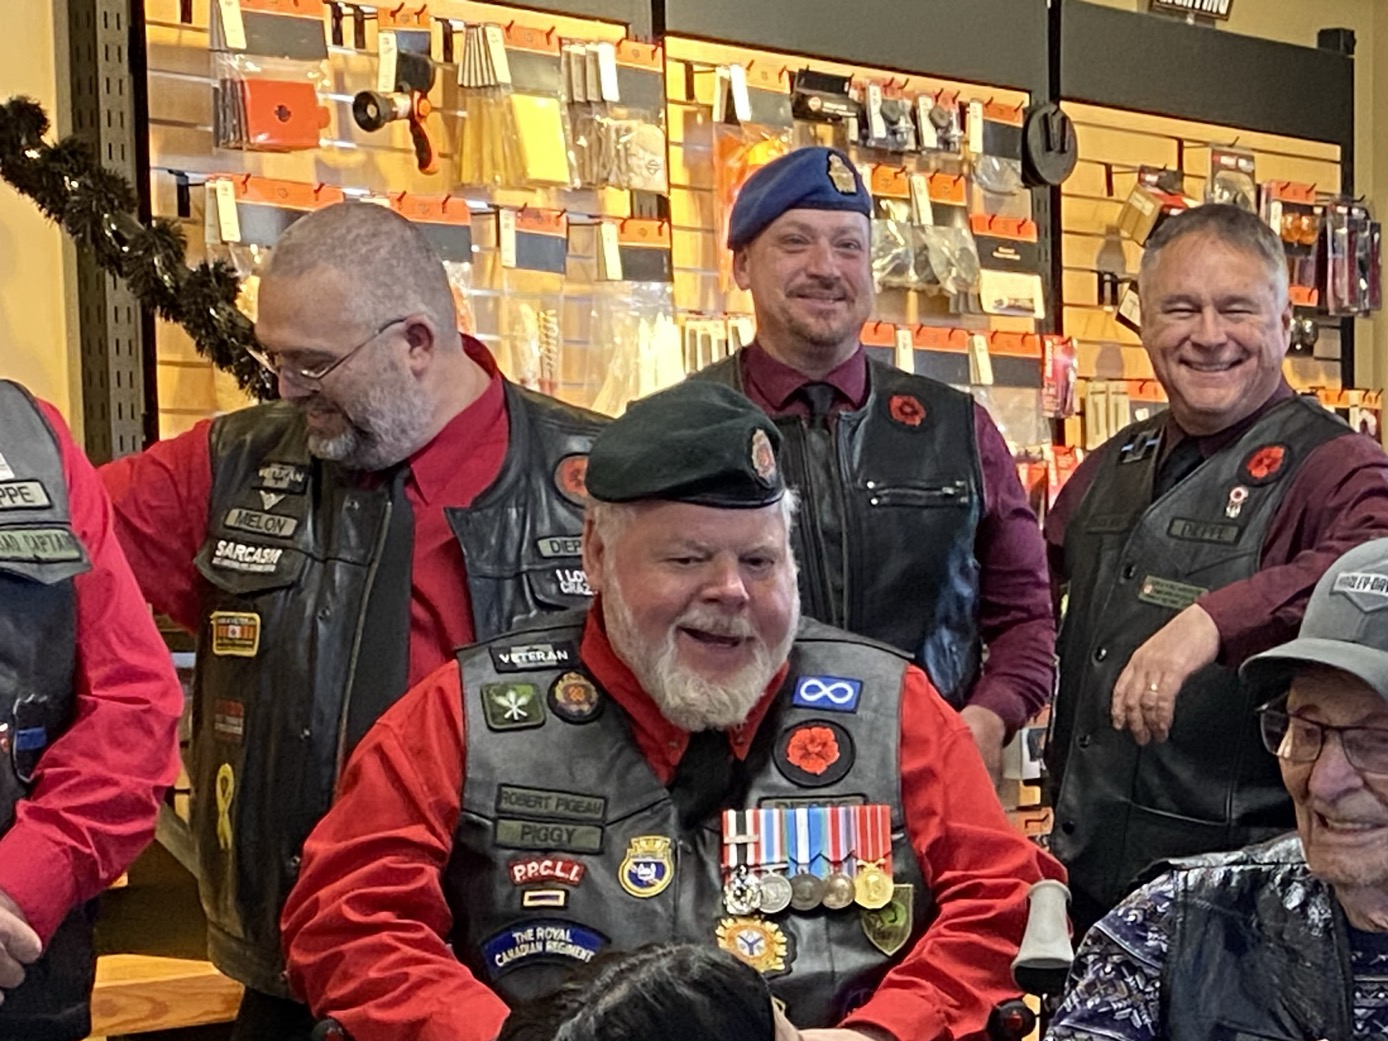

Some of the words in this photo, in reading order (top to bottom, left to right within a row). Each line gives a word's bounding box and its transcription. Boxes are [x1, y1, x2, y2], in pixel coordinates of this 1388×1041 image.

[234, 511, 286, 534] MELON
[215, 540, 283, 564] SARCASM
[499, 650, 568, 664] VETERAN
[502, 791, 553, 810] ROBERT
[521, 825, 576, 844] PIGGY
[512, 928, 535, 943] THE
[537, 927, 573, 942] ROYAL
[494, 941, 544, 967] CANADIAN
[546, 941, 595, 964] REGIMENT
